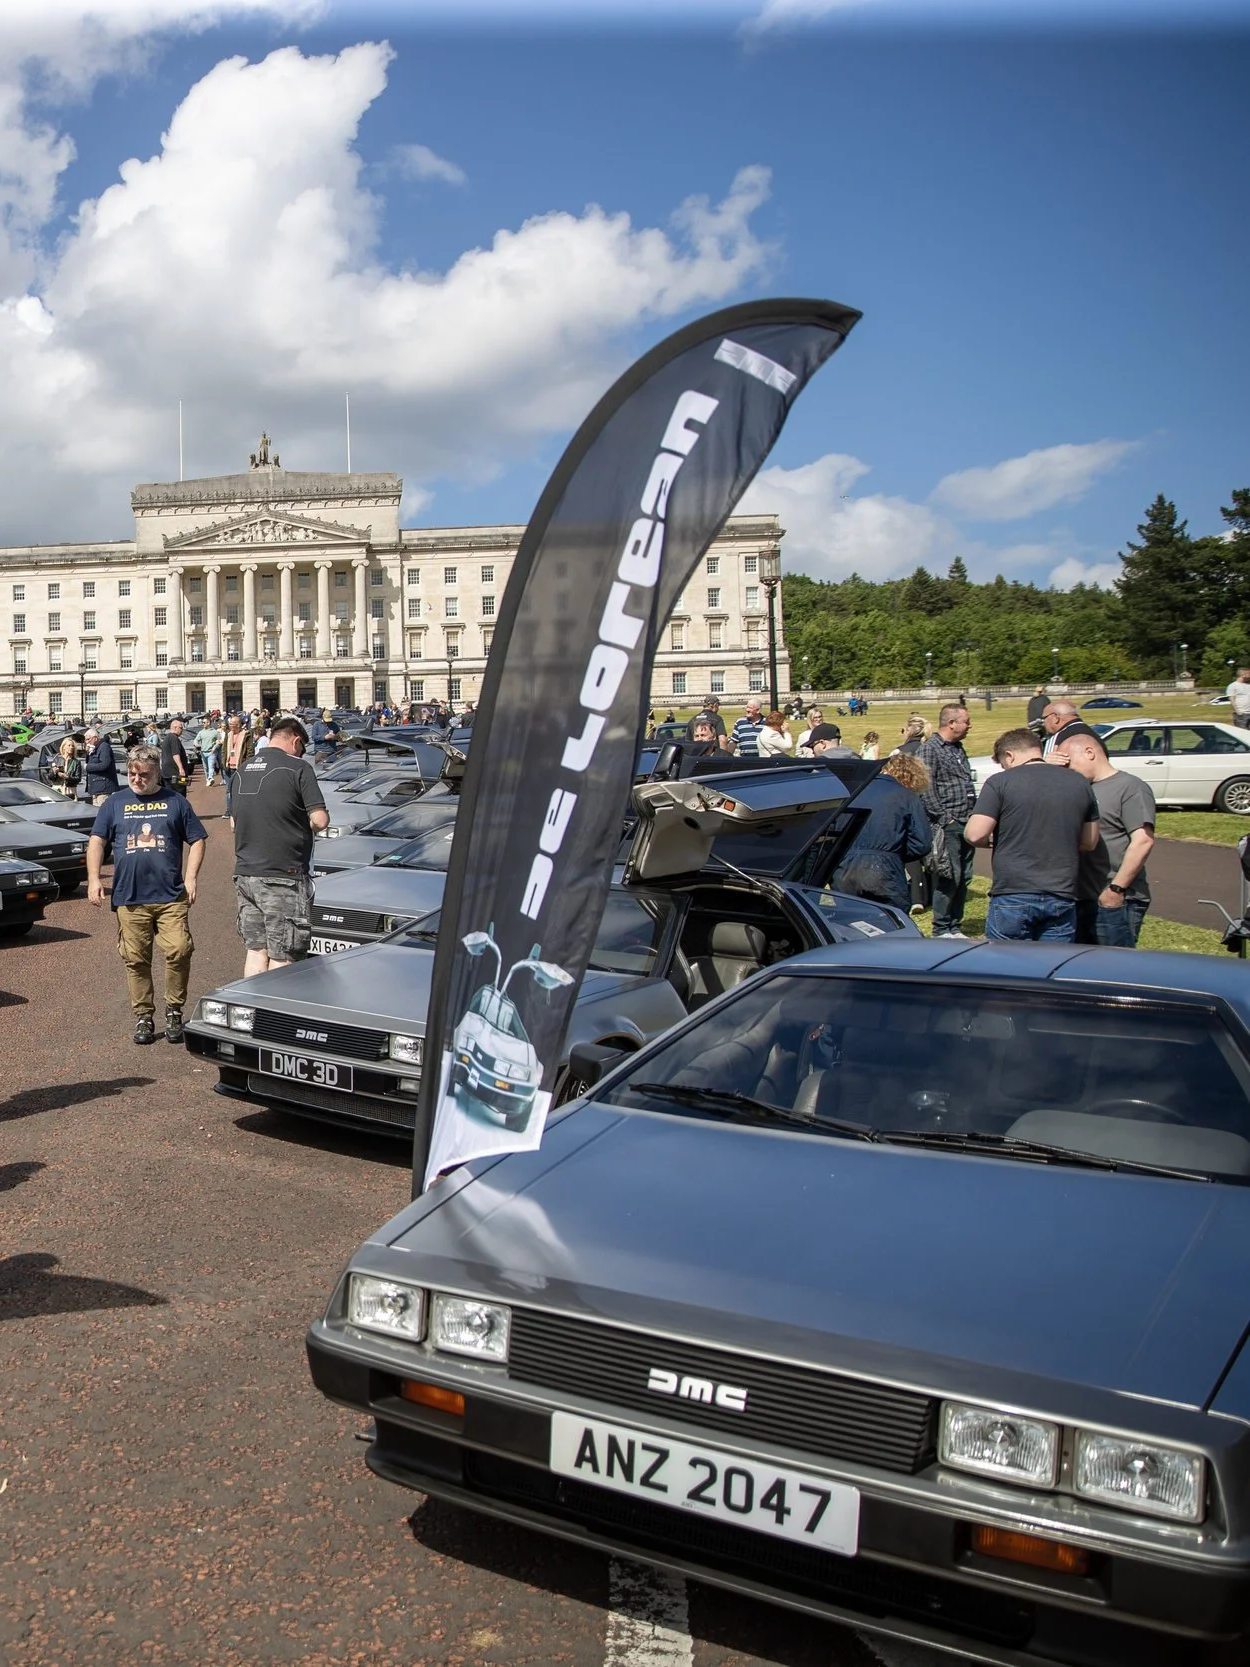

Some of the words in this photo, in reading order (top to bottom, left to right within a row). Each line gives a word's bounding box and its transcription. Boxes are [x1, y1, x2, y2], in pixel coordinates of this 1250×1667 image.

[124, 804, 145, 812] DOG
[147, 802, 168, 811] DAD
[271, 1052, 308, 1079] DMC
[312, 1061, 338, 1086] 3D
[573, 1427, 671, 1493] ANZ
[686, 1456, 832, 1534] 2047
